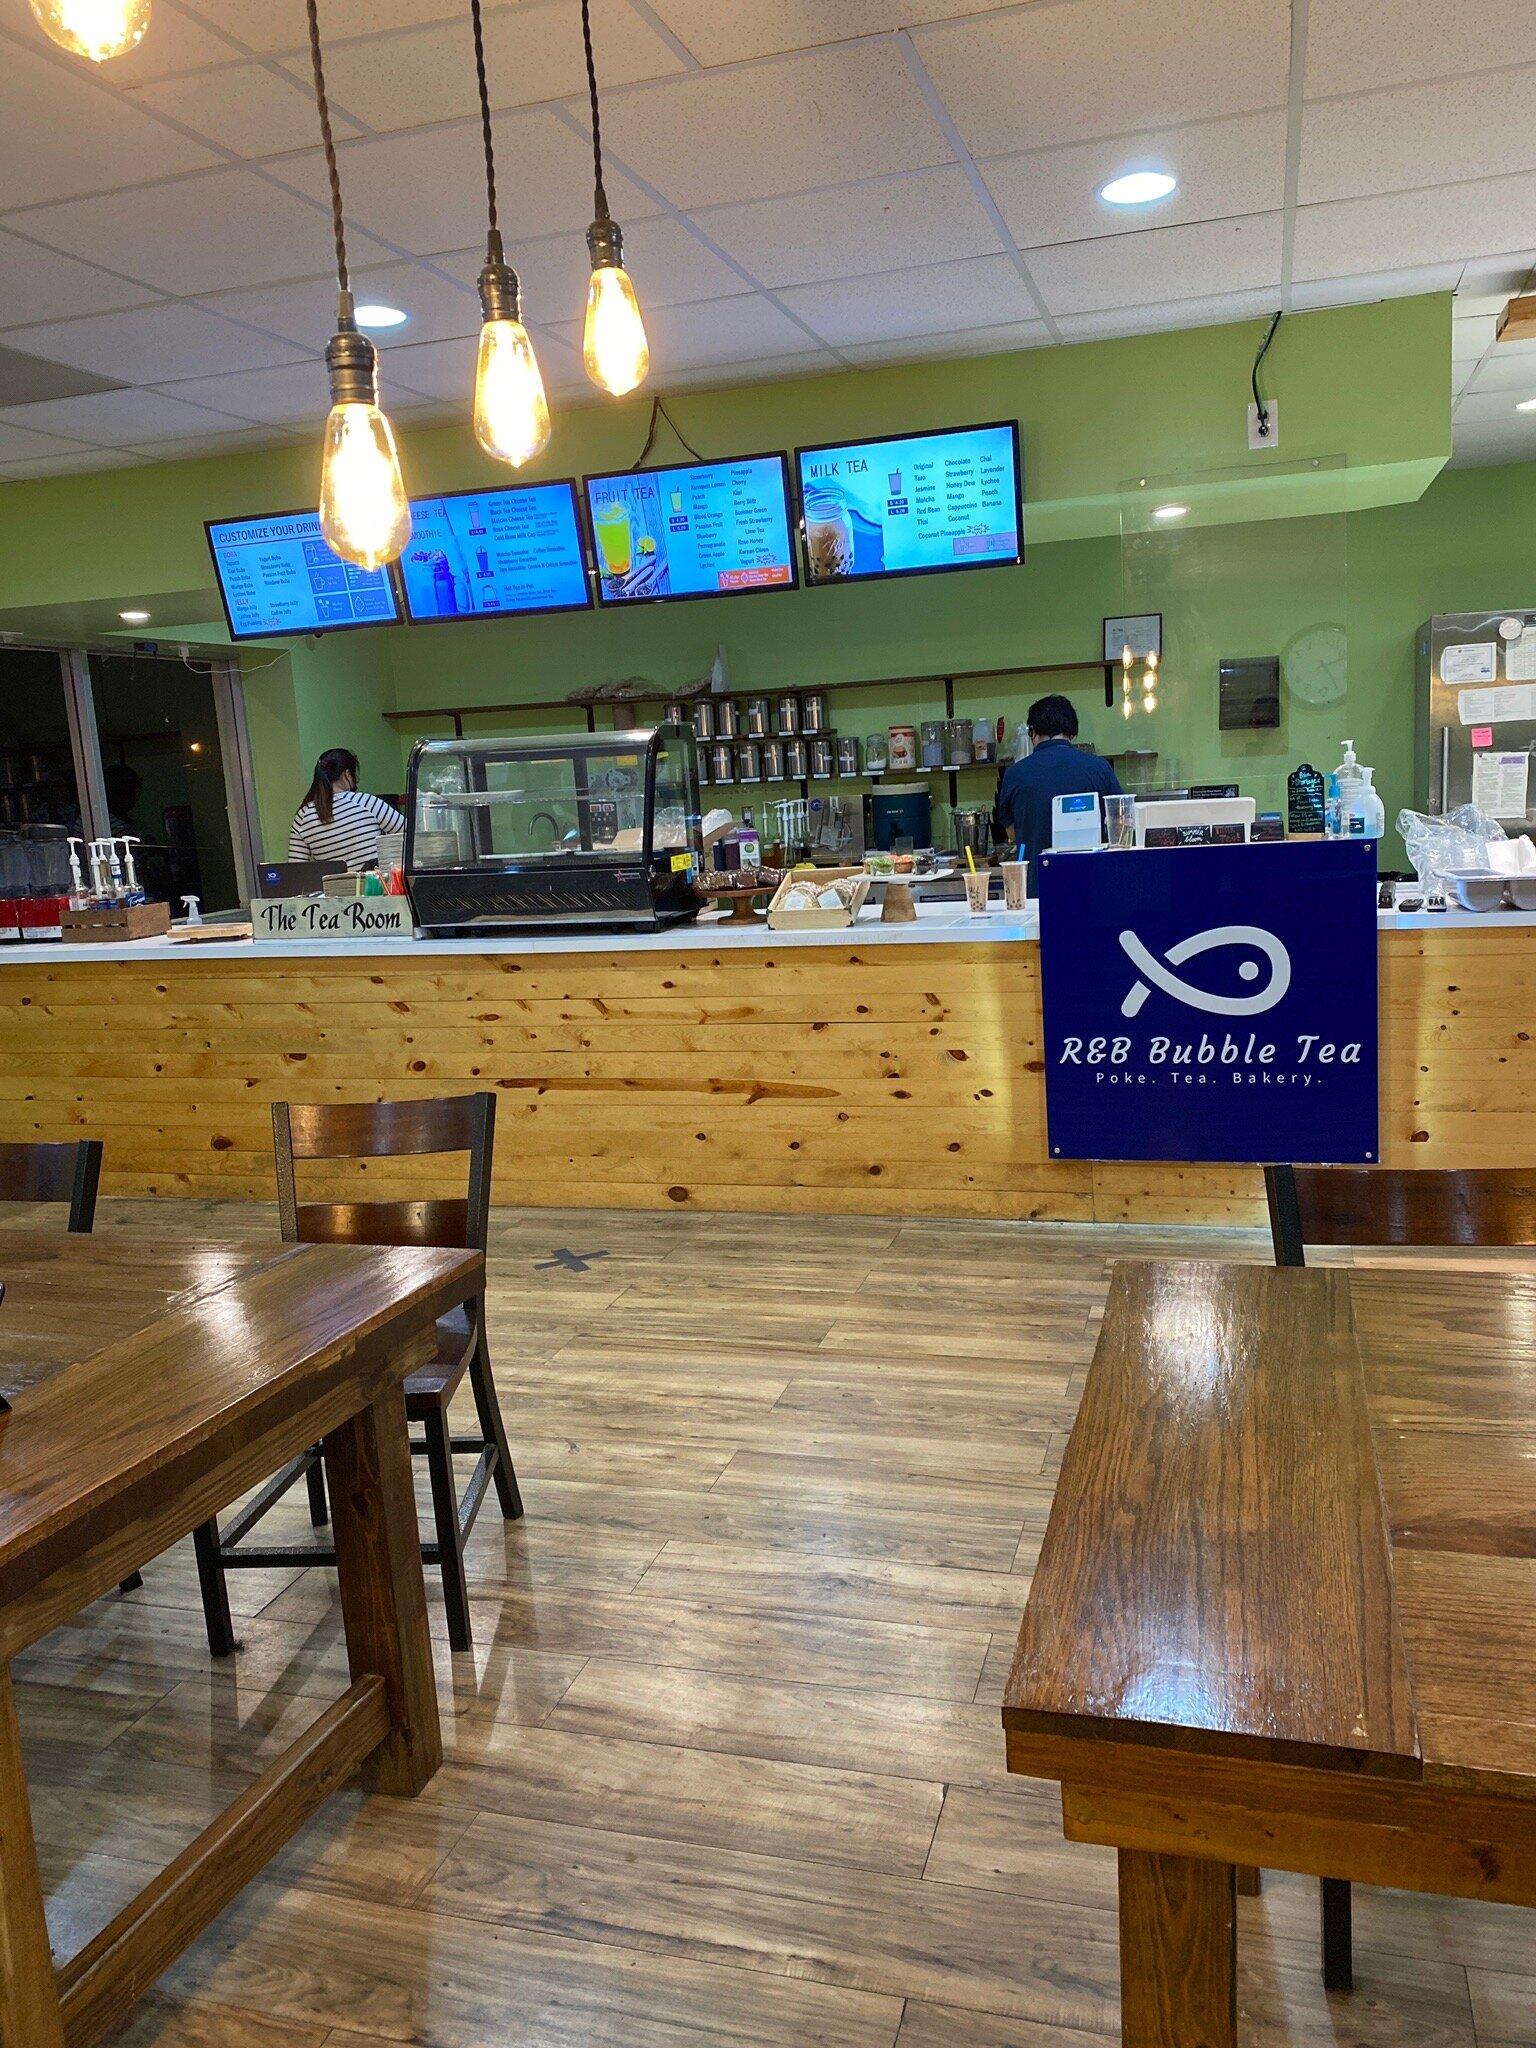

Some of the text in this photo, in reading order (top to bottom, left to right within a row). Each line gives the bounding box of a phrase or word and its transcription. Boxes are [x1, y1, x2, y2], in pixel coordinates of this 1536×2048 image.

[913, 462, 933, 471] Original
[945, 458, 971, 466] Chocolate
[810, 459, 868, 477] MILK TEA
[980, 466, 1005, 474] Lavender
[945, 469, 974, 478] Strawberry
[981, 478, 1000, 486] Lychee
[915, 485, 935, 493] Jasmine
[595, 486, 655, 504] FRUIT TEA
[947, 502, 978, 511] Cappuccino
[411, 508, 447, 520] EESE TEA
[948, 514, 970, 522] Coconut
[219, 521, 321, 543] CUSTOMIZE YOUR DRIN
[410, 529, 442, 540] MOOTHIE
[918, 531, 940, 539] Coconut
[940, 529, 966, 537] Pineapple
[260, 902, 401, 933] The Tea Room
[1060, 1033, 1362, 1065] R&B Bubble Tea
[1096, 1072, 1322, 1086] Poke. Tea. Bakery.
